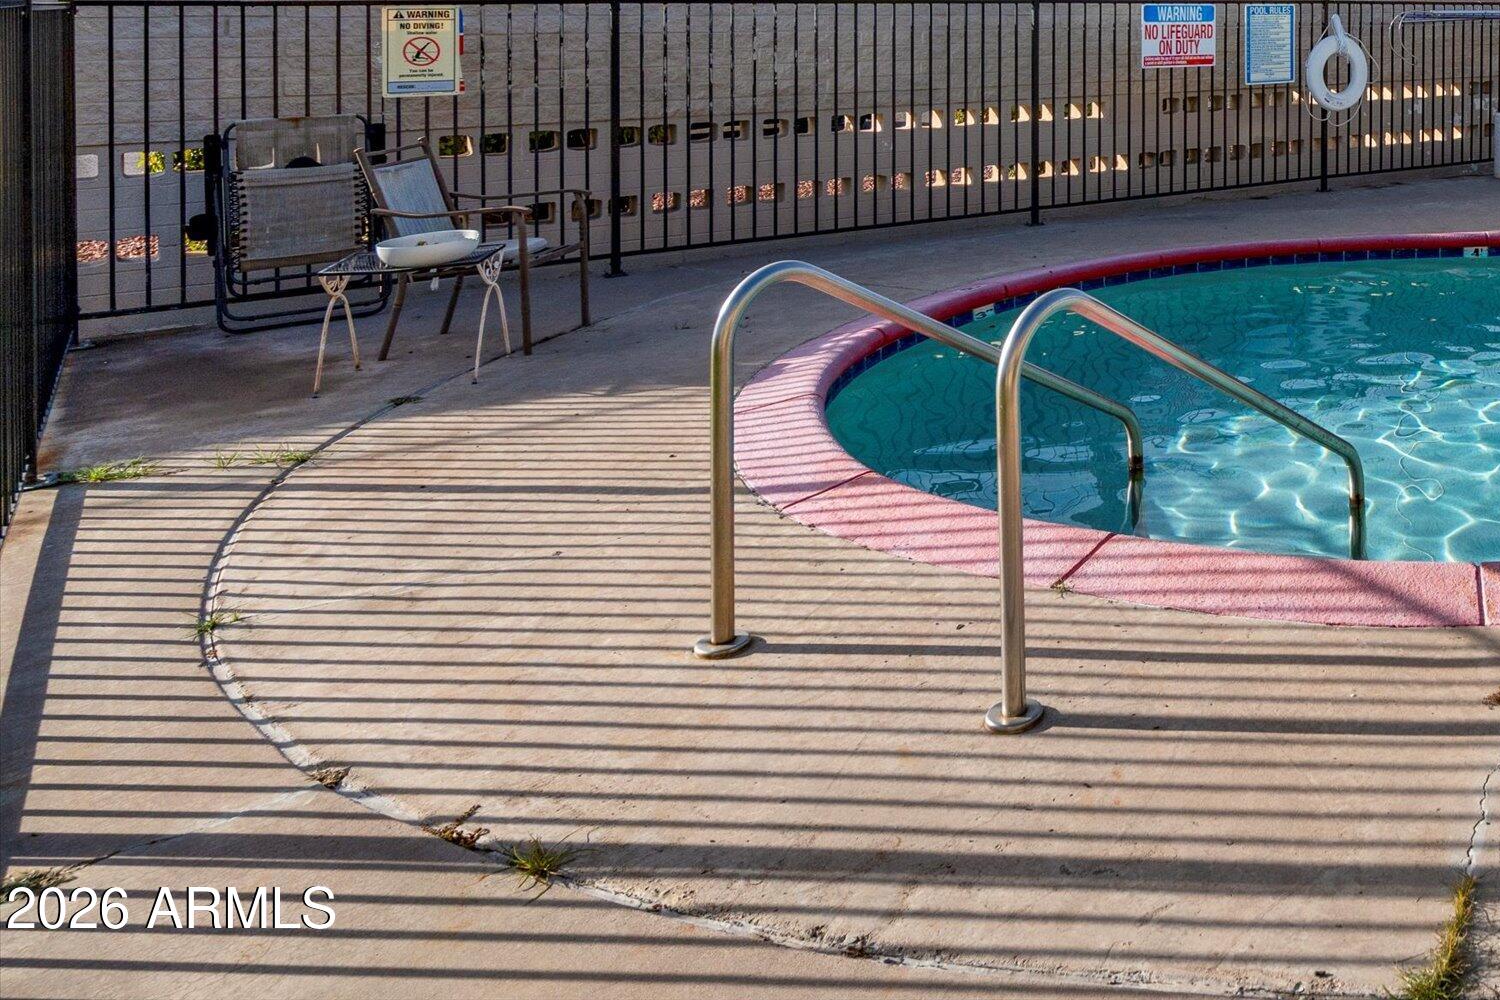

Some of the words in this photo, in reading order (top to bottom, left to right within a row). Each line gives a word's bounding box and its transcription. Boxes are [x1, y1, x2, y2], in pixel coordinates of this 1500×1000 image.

[406, 10, 450, 19] WARNING
[1157, 6, 1203, 22] WARNING
[1250, 6, 1268, 15] POOL
[1269, 6, 1291, 15] RULES
[399, 22, 411, 30] NO
[413, 22, 444, 30] DIVING!
[1144, 24, 1159, 40] NO
[1161, 24, 1213, 40] LIFEGUARD
[1158, 40, 1172, 55] ON
[1175, 39, 1200, 55] DUTY
